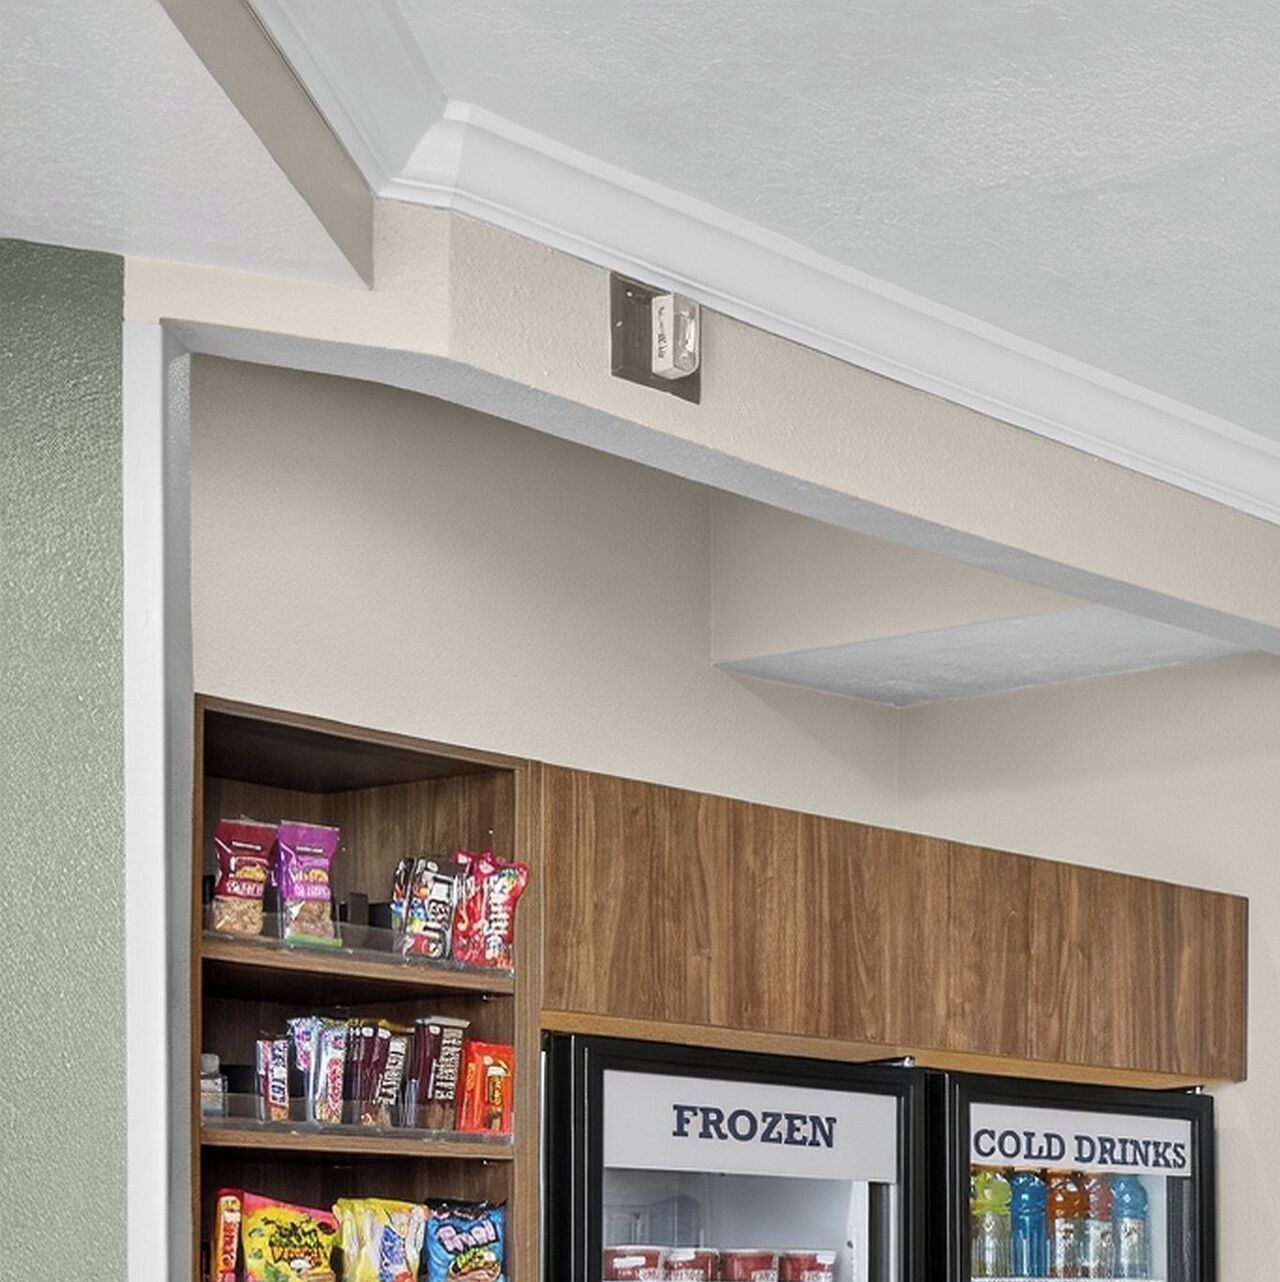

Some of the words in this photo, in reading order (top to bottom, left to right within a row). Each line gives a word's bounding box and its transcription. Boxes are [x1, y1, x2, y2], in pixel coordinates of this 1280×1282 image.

[671, 1103, 838, 1149] FROZEN
[973, 1128, 1066, 1161] COLD
[1073, 1134, 1187, 1170] DRINKS
